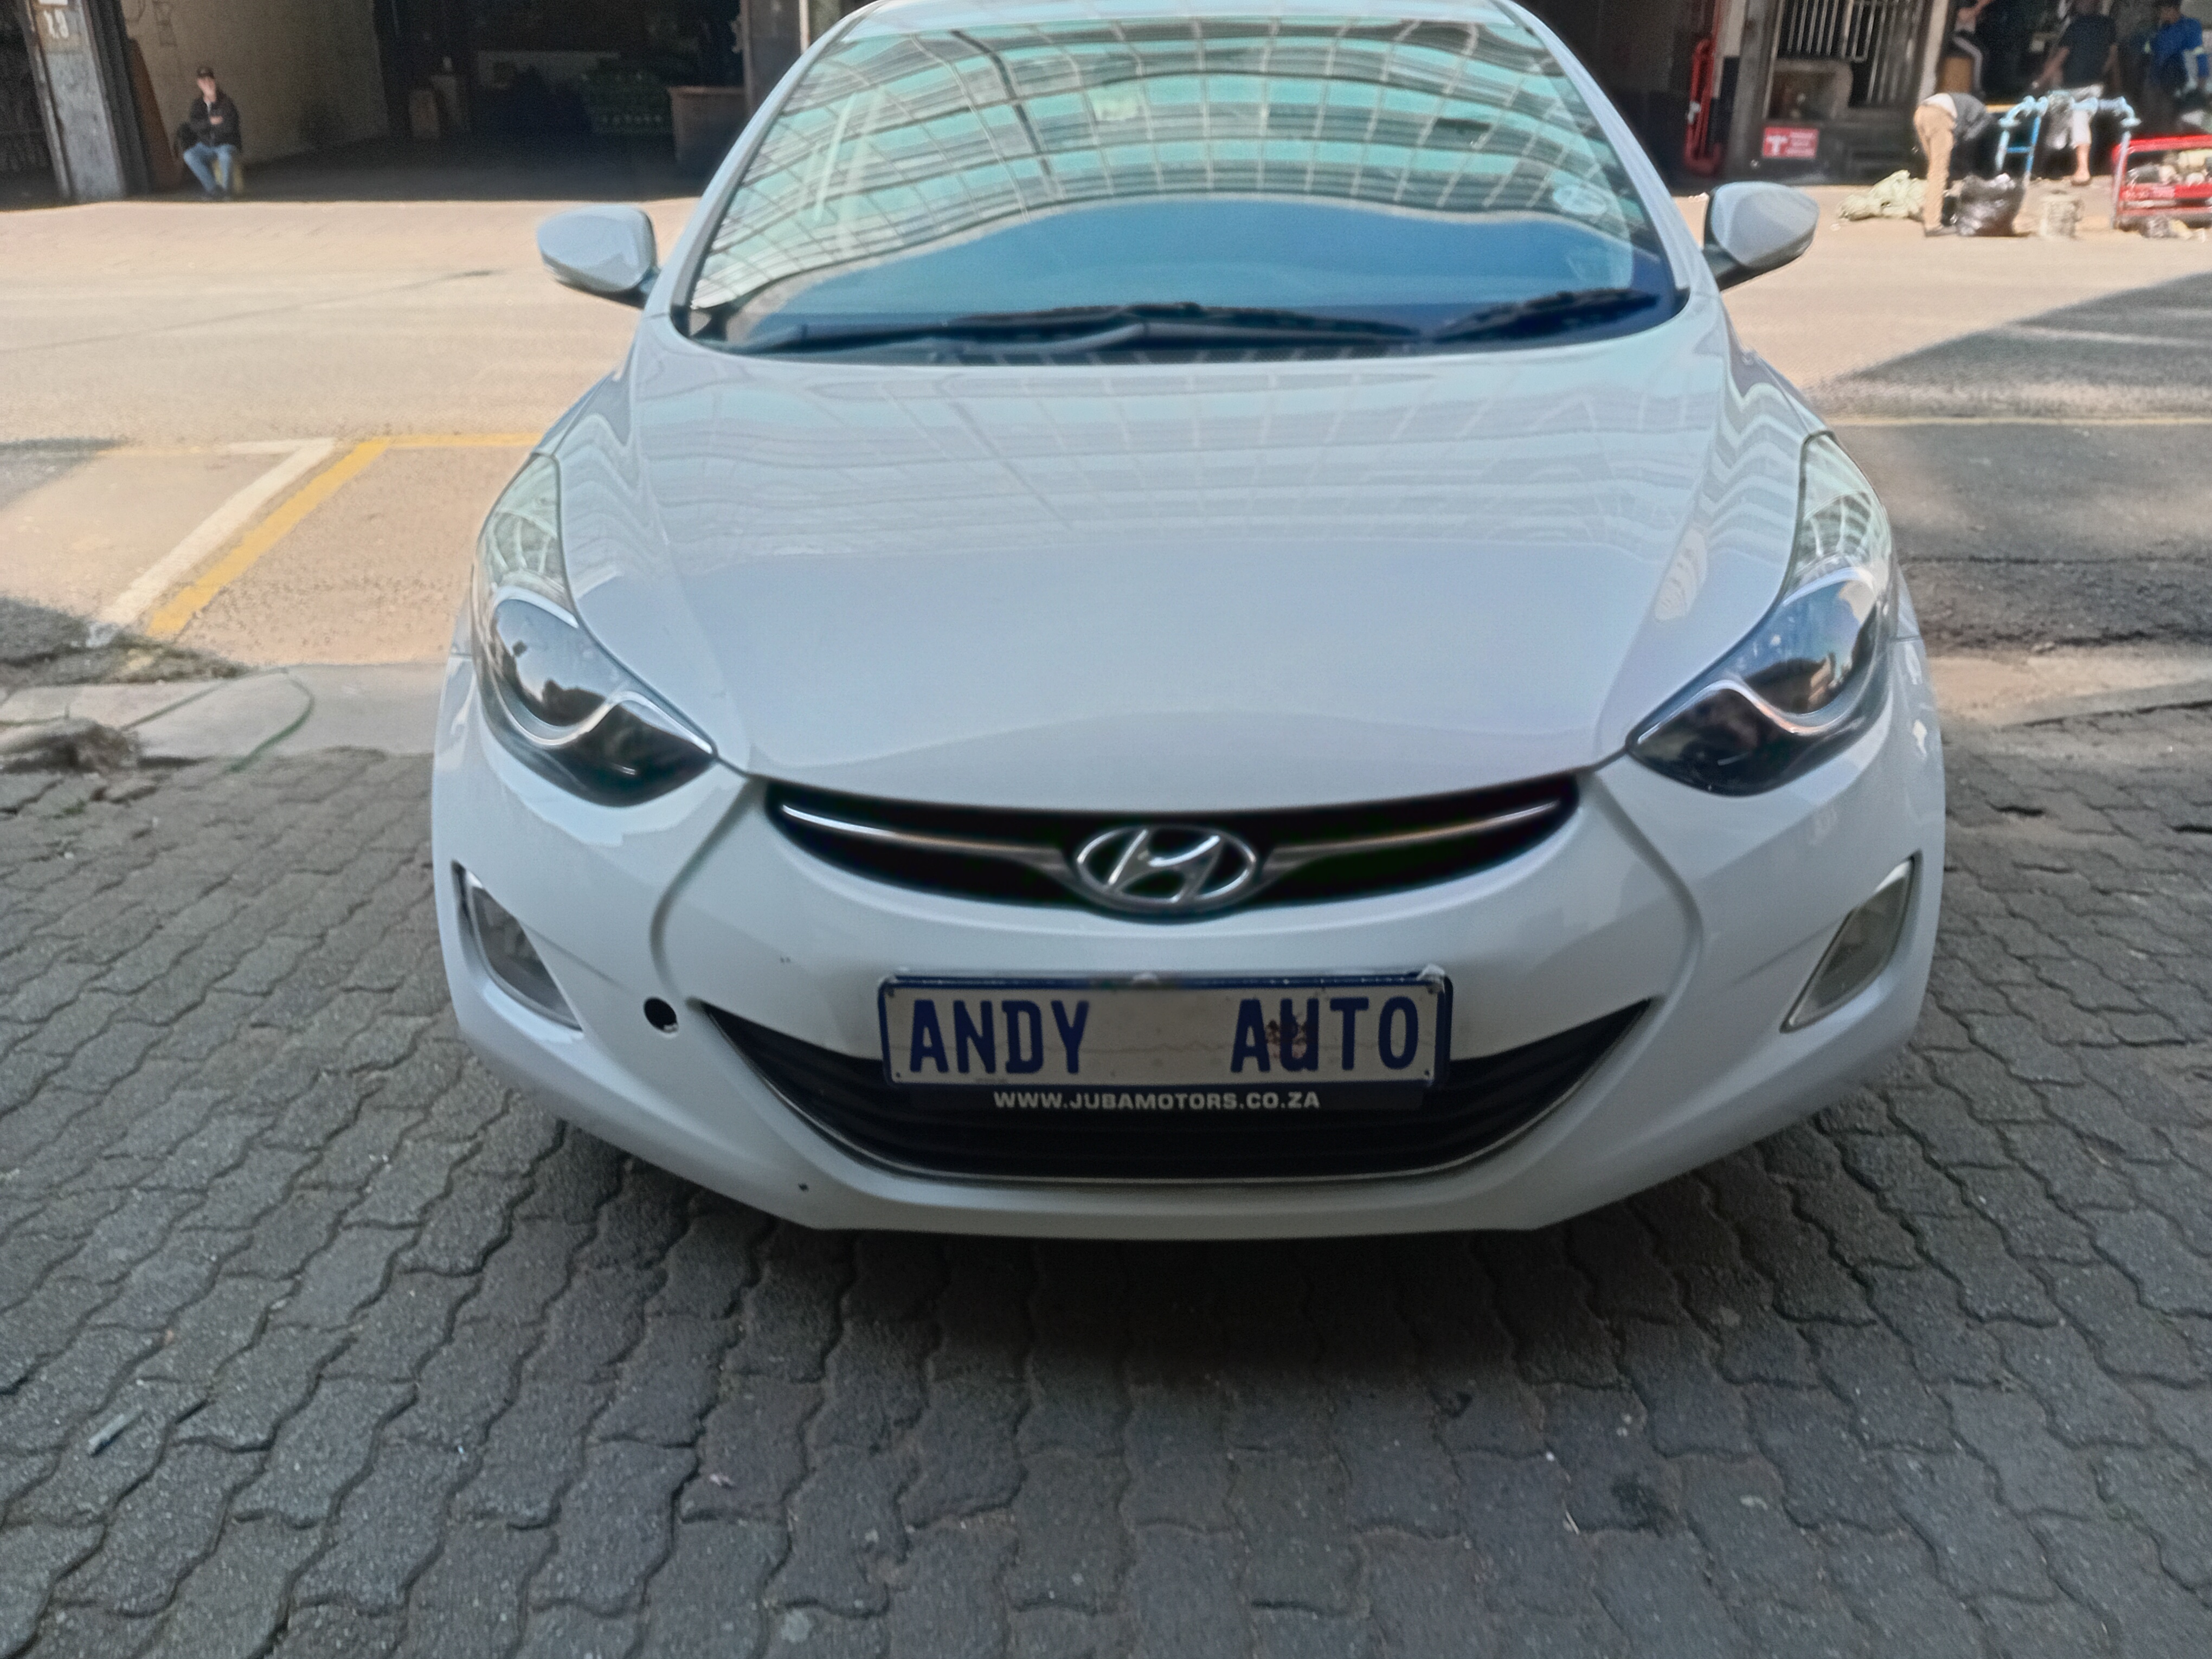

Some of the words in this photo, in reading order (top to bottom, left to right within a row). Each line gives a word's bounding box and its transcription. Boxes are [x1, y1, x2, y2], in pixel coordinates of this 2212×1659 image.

[910, 999, 1090, 1074] ANDY
[1230, 996, 1419, 1073] AUTO
[993, 1091, 1321, 1110] WWW.JUBAMOTORS.CO.ZA
